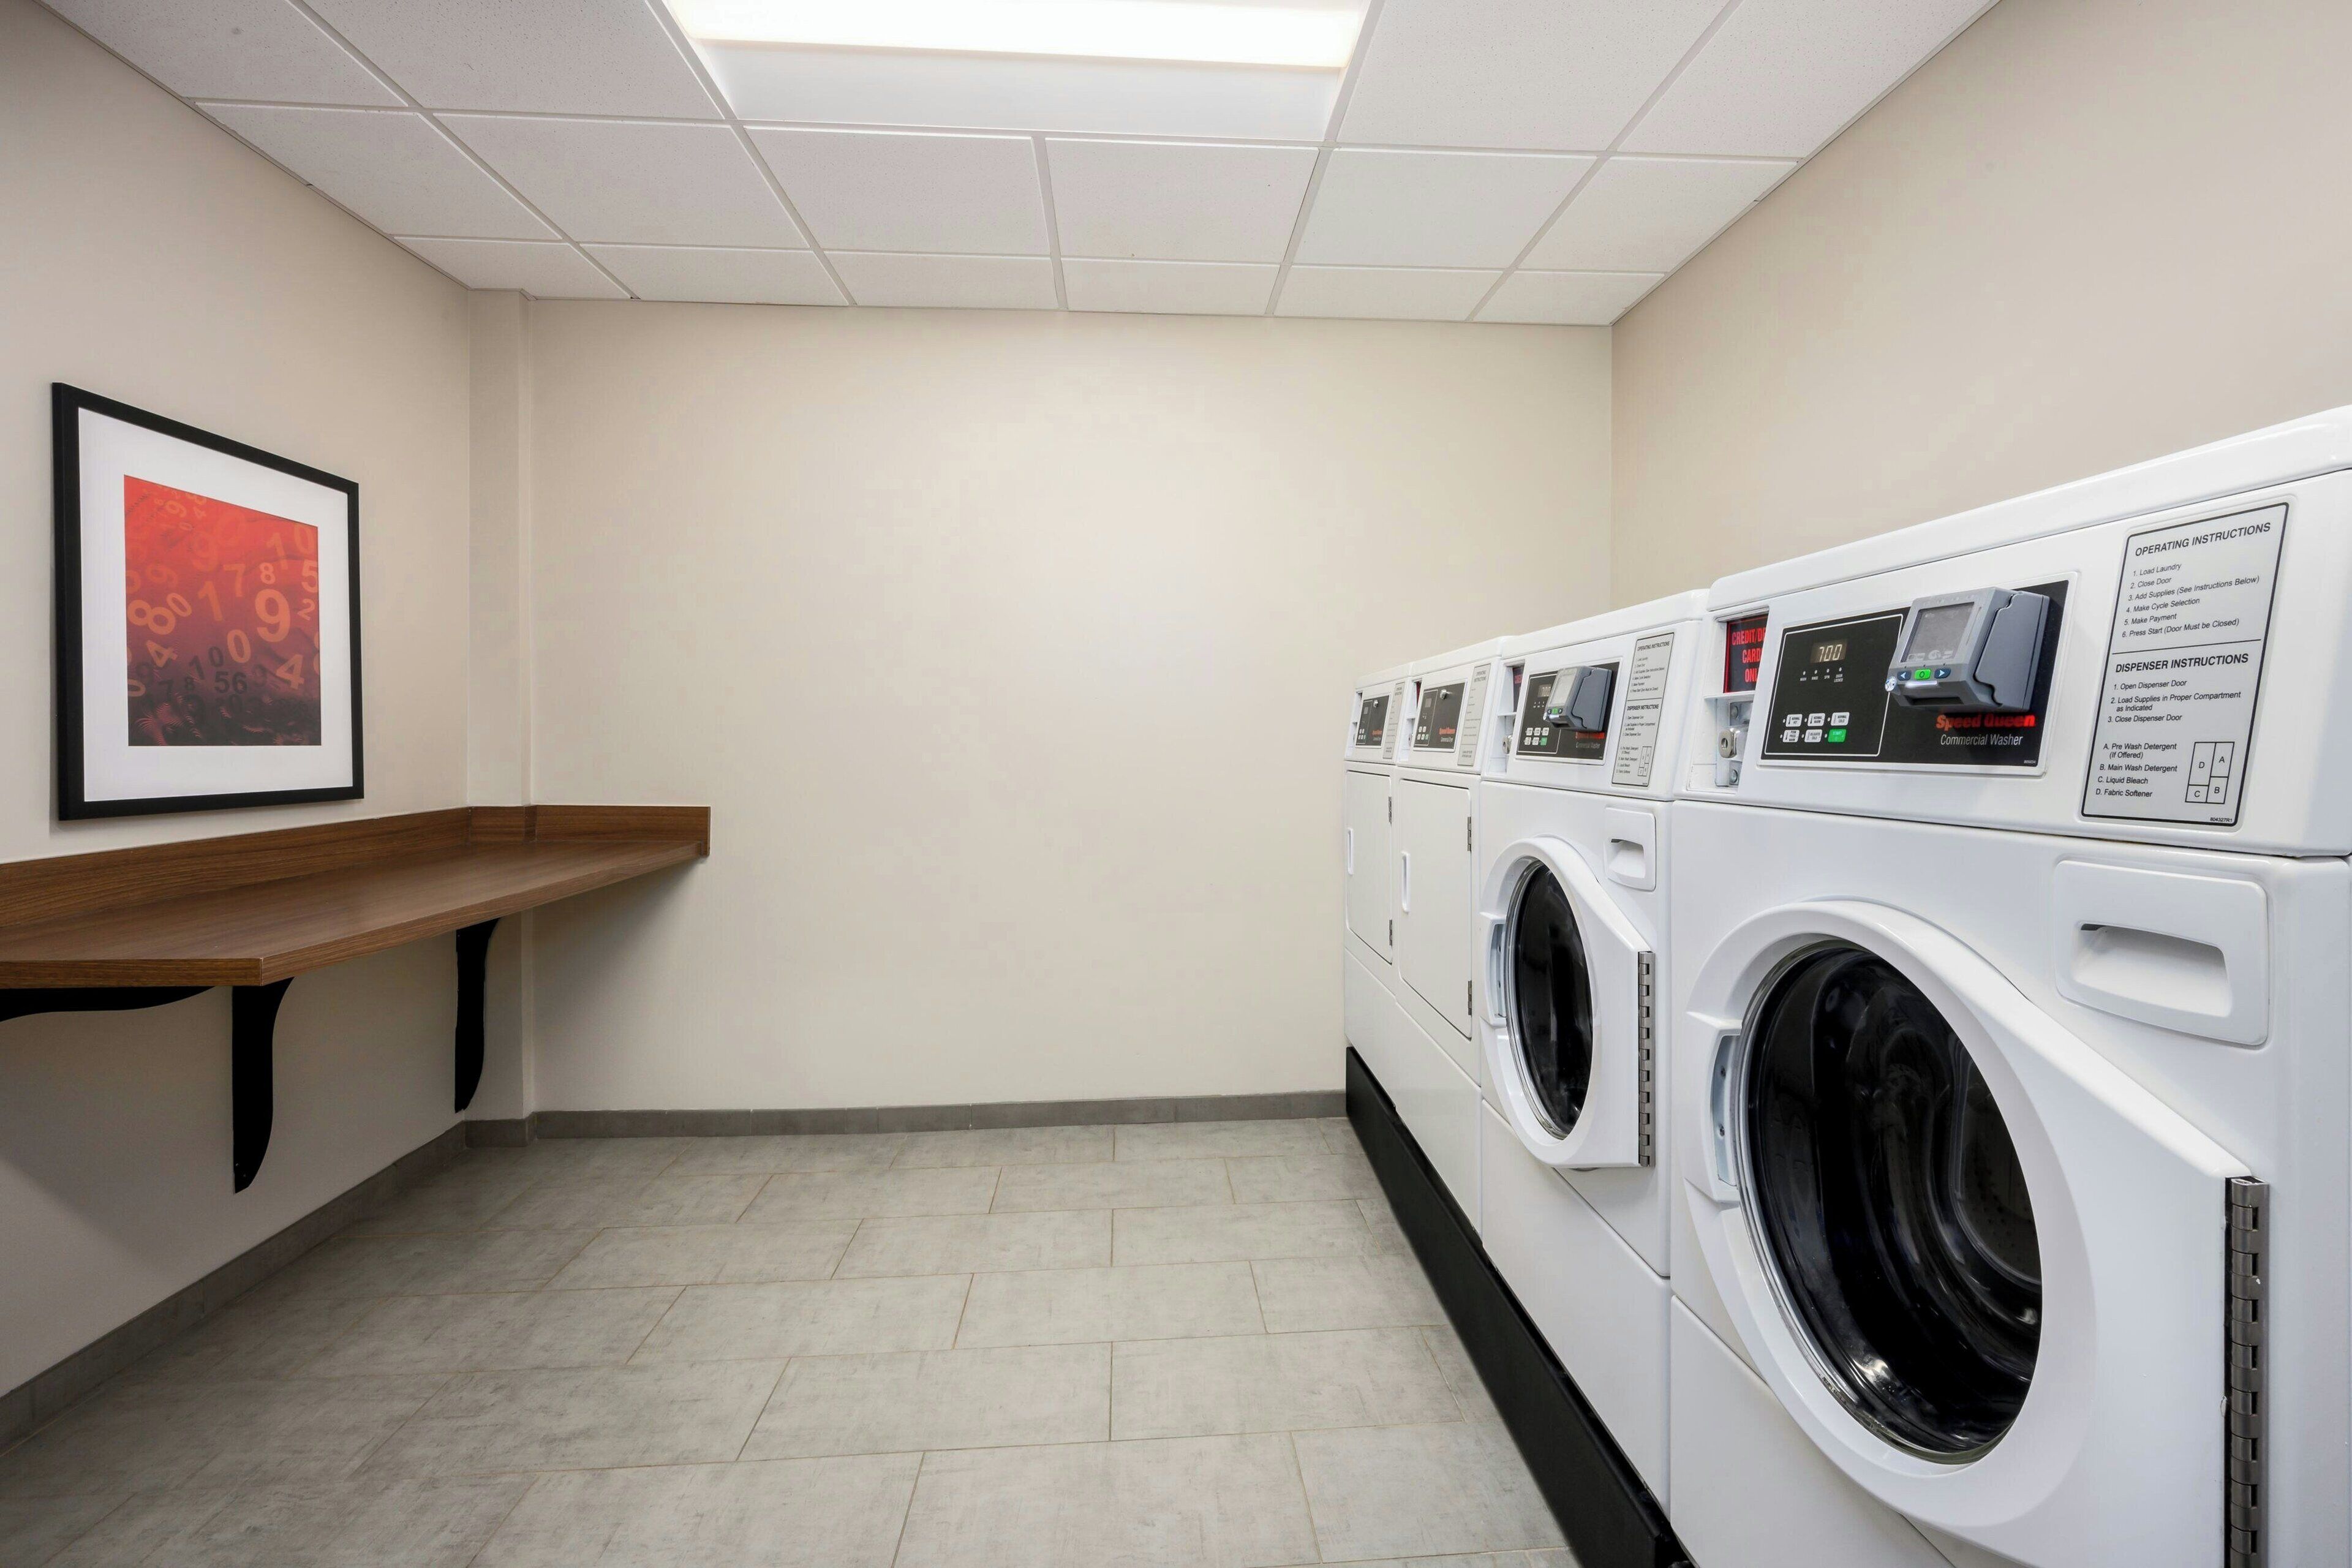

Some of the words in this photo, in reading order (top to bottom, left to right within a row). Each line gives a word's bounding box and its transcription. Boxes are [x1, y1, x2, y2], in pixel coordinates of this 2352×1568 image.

[2135, 538, 2189, 556] OPERATING
[2192, 522, 2271, 546] INSTRUCTIONS
[259, 562, 276, 584] 8
[301, 559, 318, 593] 5
[2139, 567, 2154, 576] Load
[2156, 563, 2182, 573] Laundry
[223, 564, 245, 597] 7
[2135, 592, 2147, 601] Add
[2149, 589, 2175, 600] Supplies
[2176, 586, 2192, 595] (See
[2194, 581, 2233, 592] Instructions
[2234, 575, 2260, 586] Below)
[2138, 579, 2154, 588] Close
[2156, 577, 2172, 586] Door
[198, 581, 224, 621] 1
[297, 598, 315, 621] 2
[2133, 604, 2150, 612] Make
[2151, 601, 2169, 611] Cycle
[2171, 597, 2200, 607] Selection
[254, 589, 290, 643] 9
[2131, 616, 2147, 625] Make
[2149, 613, 2177, 624] Payment
[2129, 628, 2146, 637] Press
[2164, 624, 2182, 635] (Door
[2184, 622, 2200, 631] Must
[2212, 618, 2239, 628] Closed)
[227, 629, 251, 663] 0
[1742, 648, 1761, 663] CARD
[1819, 644, 1842, 662] 700
[276, 654, 304, 690] 4
[2115, 660, 2168, 673] DISPENSER
[2171, 653, 2249, 668] INSTRUCTIONS
[2138, 680, 2169, 690] Dispenser
[2134, 695, 2160, 704] Supplies
[2169, 693, 2192, 702] Proper
[2193, 691, 2241, 701] Compartment
[1936, 712, 1981, 731] Speed
[1984, 713, 2035, 728] Queen
[2133, 714, 2165, 723] Dispenser
[1940, 734, 1988, 745] Commercial
[1991, 734, 2023, 745] Washer
[2144, 743, 2177, 752] Detergent
[2106, 777, 2124, 785] Liquid
